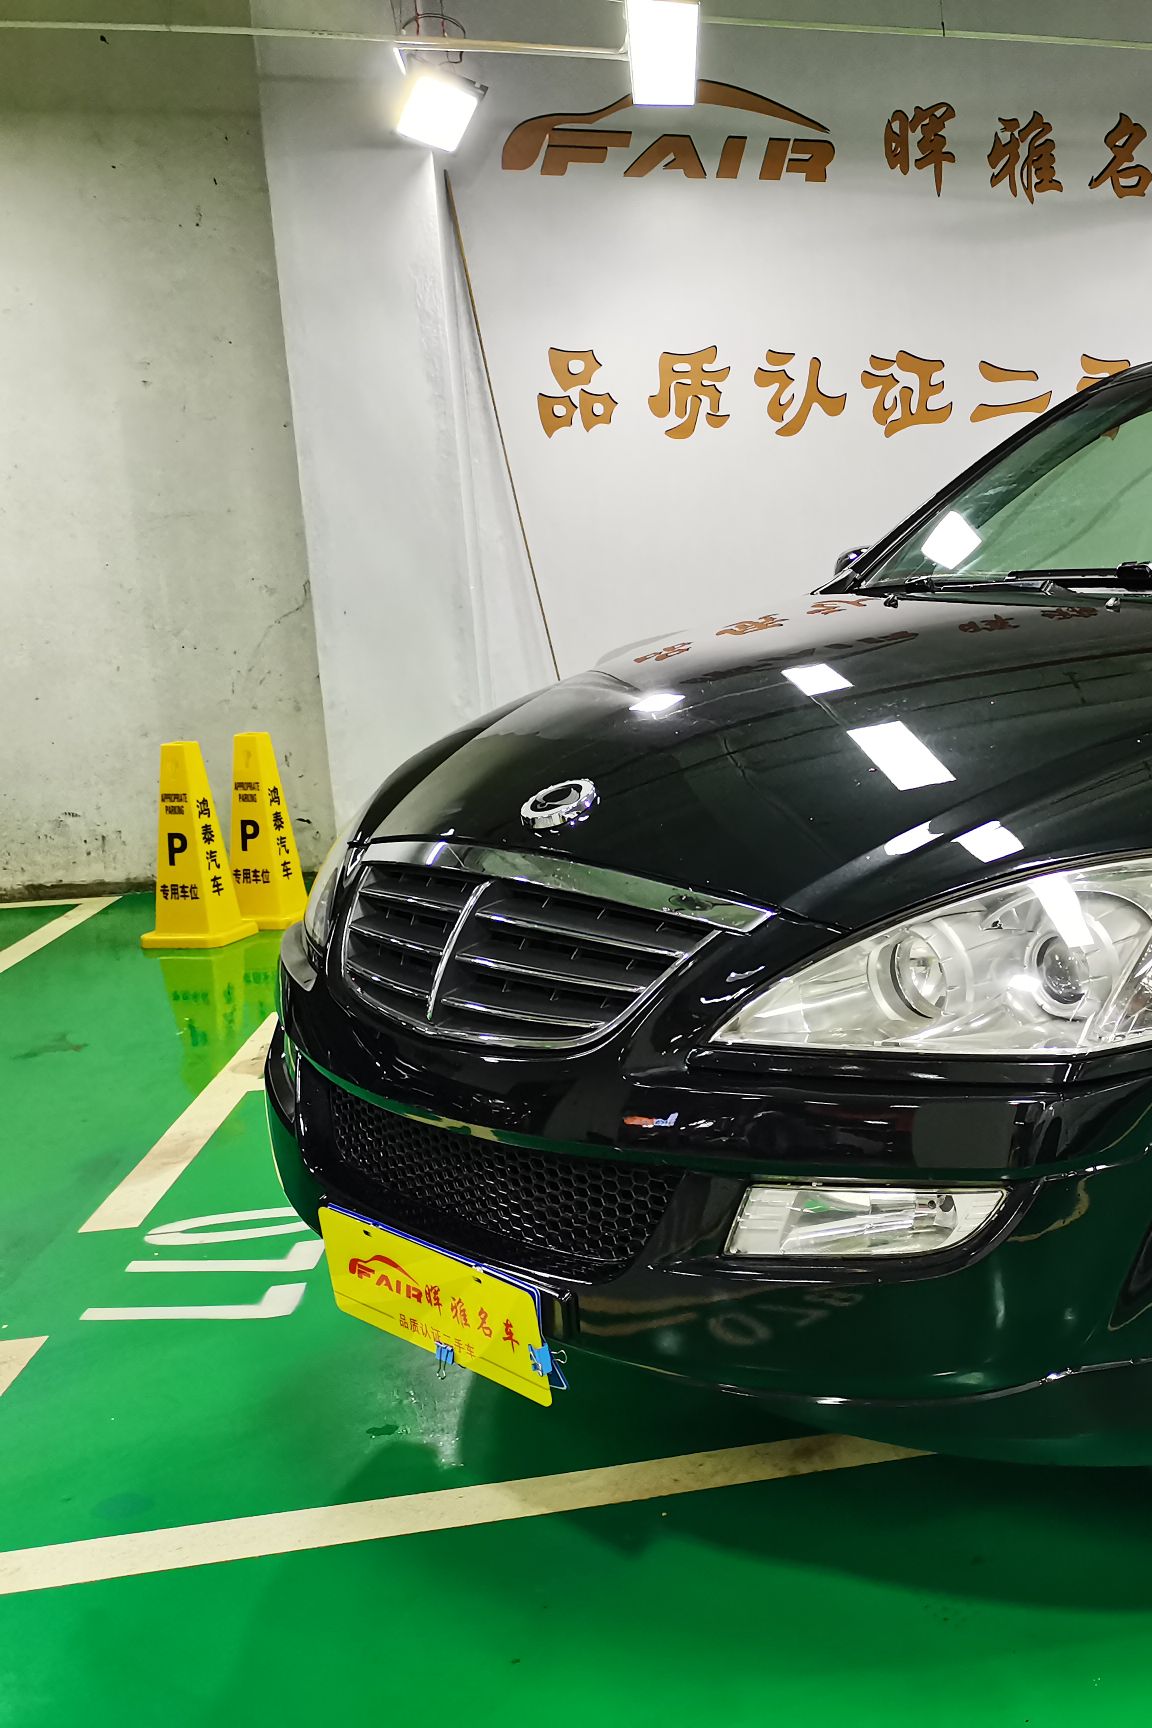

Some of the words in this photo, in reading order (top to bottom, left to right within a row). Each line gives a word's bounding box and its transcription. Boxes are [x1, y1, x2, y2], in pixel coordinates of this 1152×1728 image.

[541, 130, 835, 183] FAIR
[167, 832, 188, 866] P
[196, 797, 224, 896] 鸿泰汽车
[240, 819, 260, 851] P
[268, 786, 292, 880] 鸿泰汽车
[160, 884, 200, 900] 专用车位
[233, 868, 270, 884] 专用车位
[355, 1265, 423, 1303] FAIR
[425, 1285, 520, 1352] 晖雅名车
